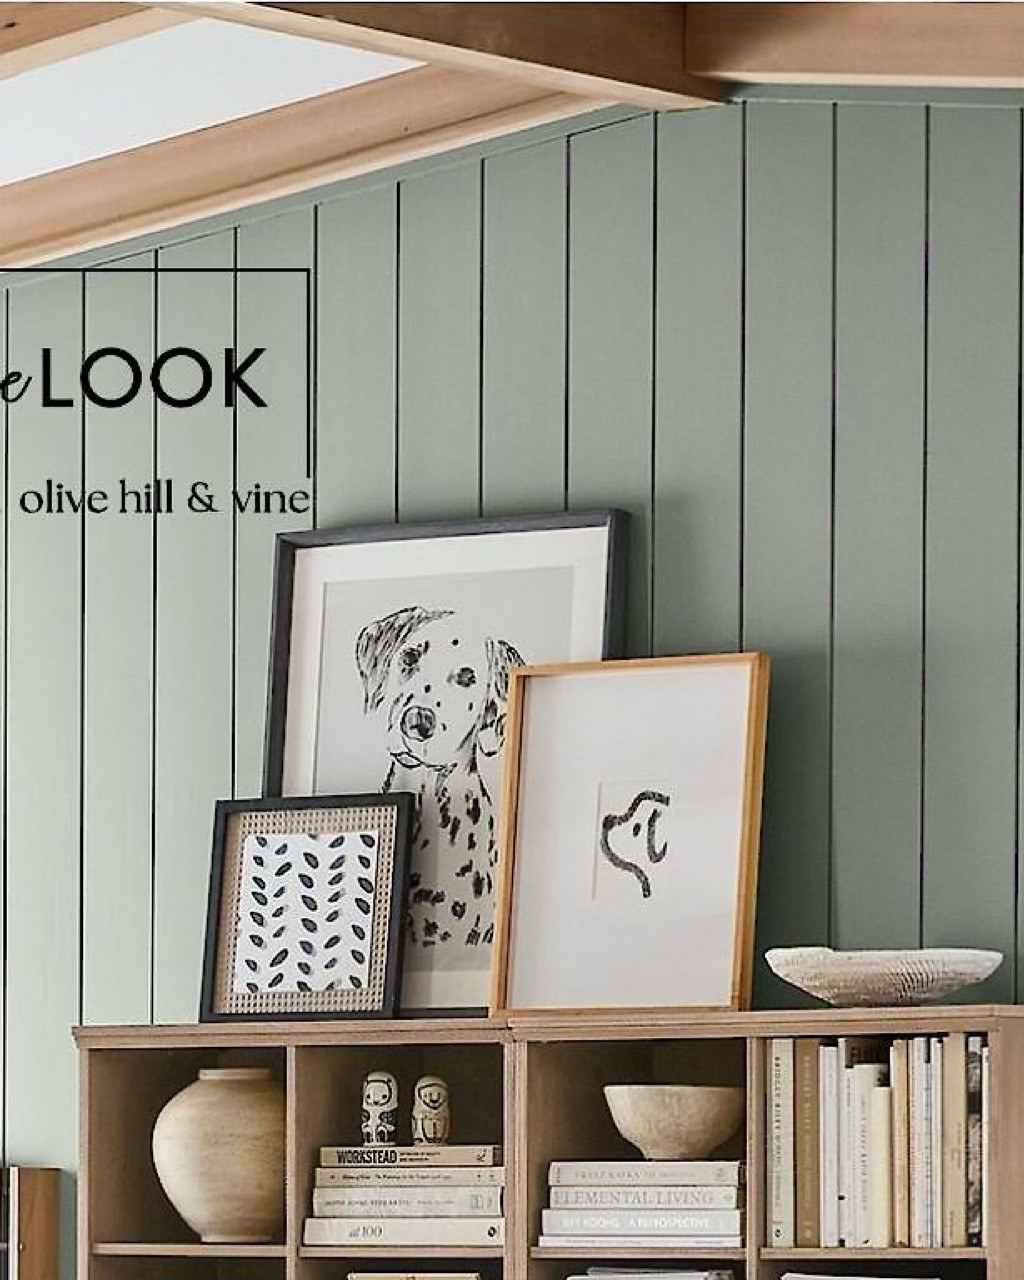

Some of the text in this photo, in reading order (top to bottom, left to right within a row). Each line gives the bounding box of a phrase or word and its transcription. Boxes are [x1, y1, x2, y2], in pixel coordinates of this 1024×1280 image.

[336, 1149, 398, 1164] WORKSTEAD
[554, 1190, 714, 1205] ELEMENTAL LIVING
